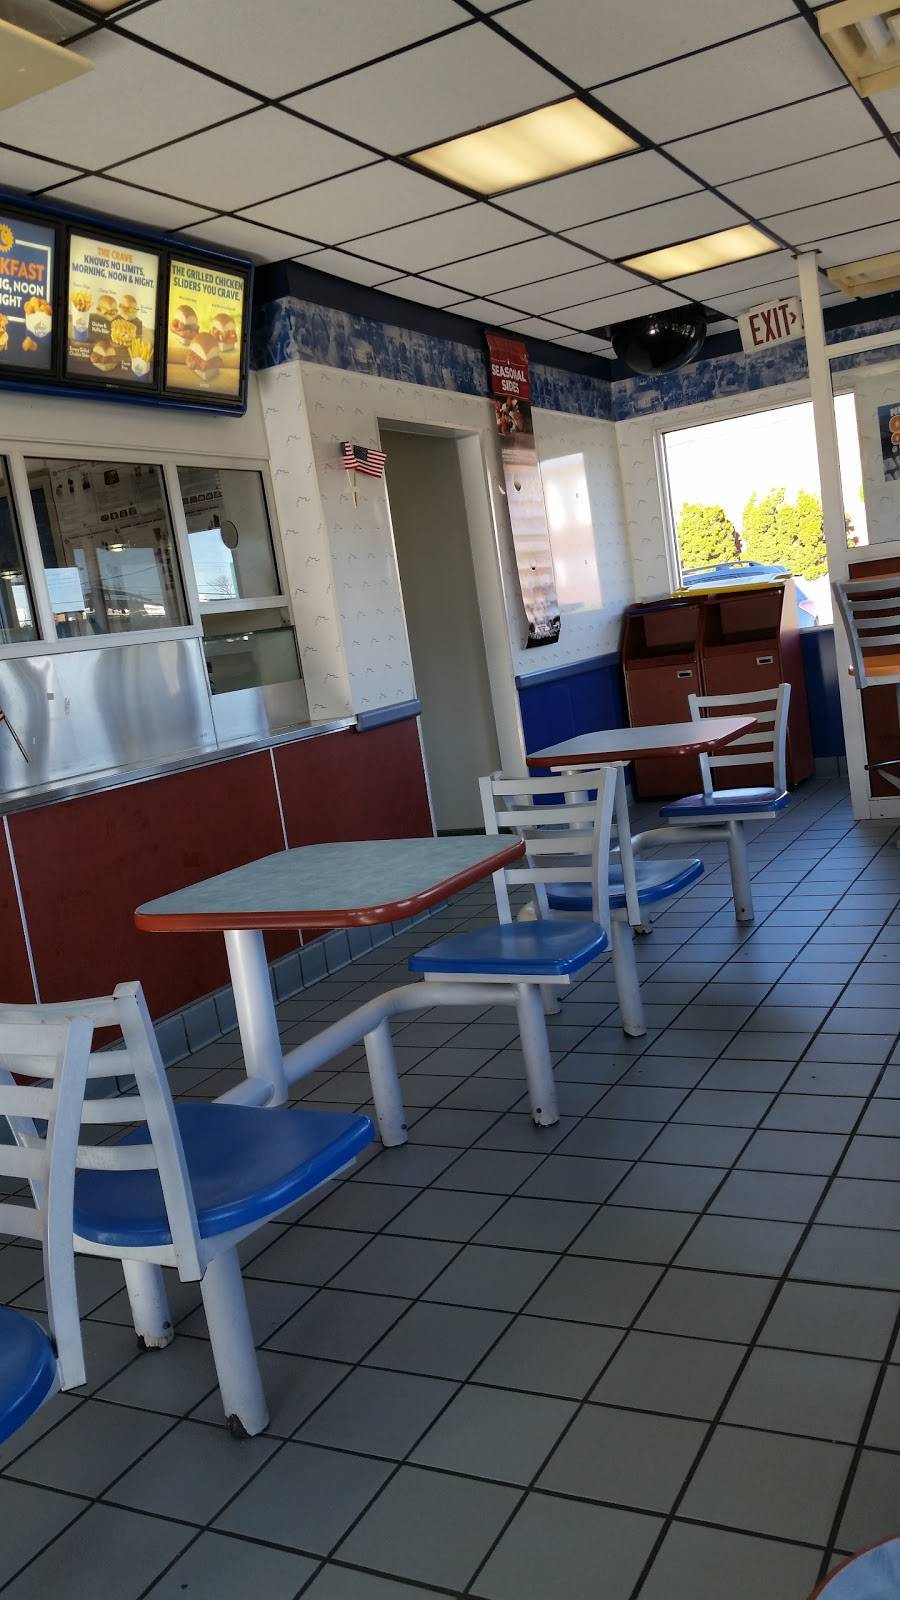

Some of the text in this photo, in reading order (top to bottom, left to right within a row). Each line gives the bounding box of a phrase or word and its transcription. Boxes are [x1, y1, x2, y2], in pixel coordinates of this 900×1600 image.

[84, 254, 109, 268] KNOWS
[110, 260, 121, 271] NO
[97, 247, 134, 263] THE CRAVE
[72, 262, 155, 289] MORNING, NOON & NIGHT.
[171, 264, 243, 291] THE GRILLED CHICKEN
[13, 280, 44, 297] NOON
[173, 277, 241, 301] SLIDERS YOU CRAVE.
[748, 303, 791, 347] EXIT
[491, 363, 528, 383] SEASONAL
[501, 379, 520, 394] SIDES
